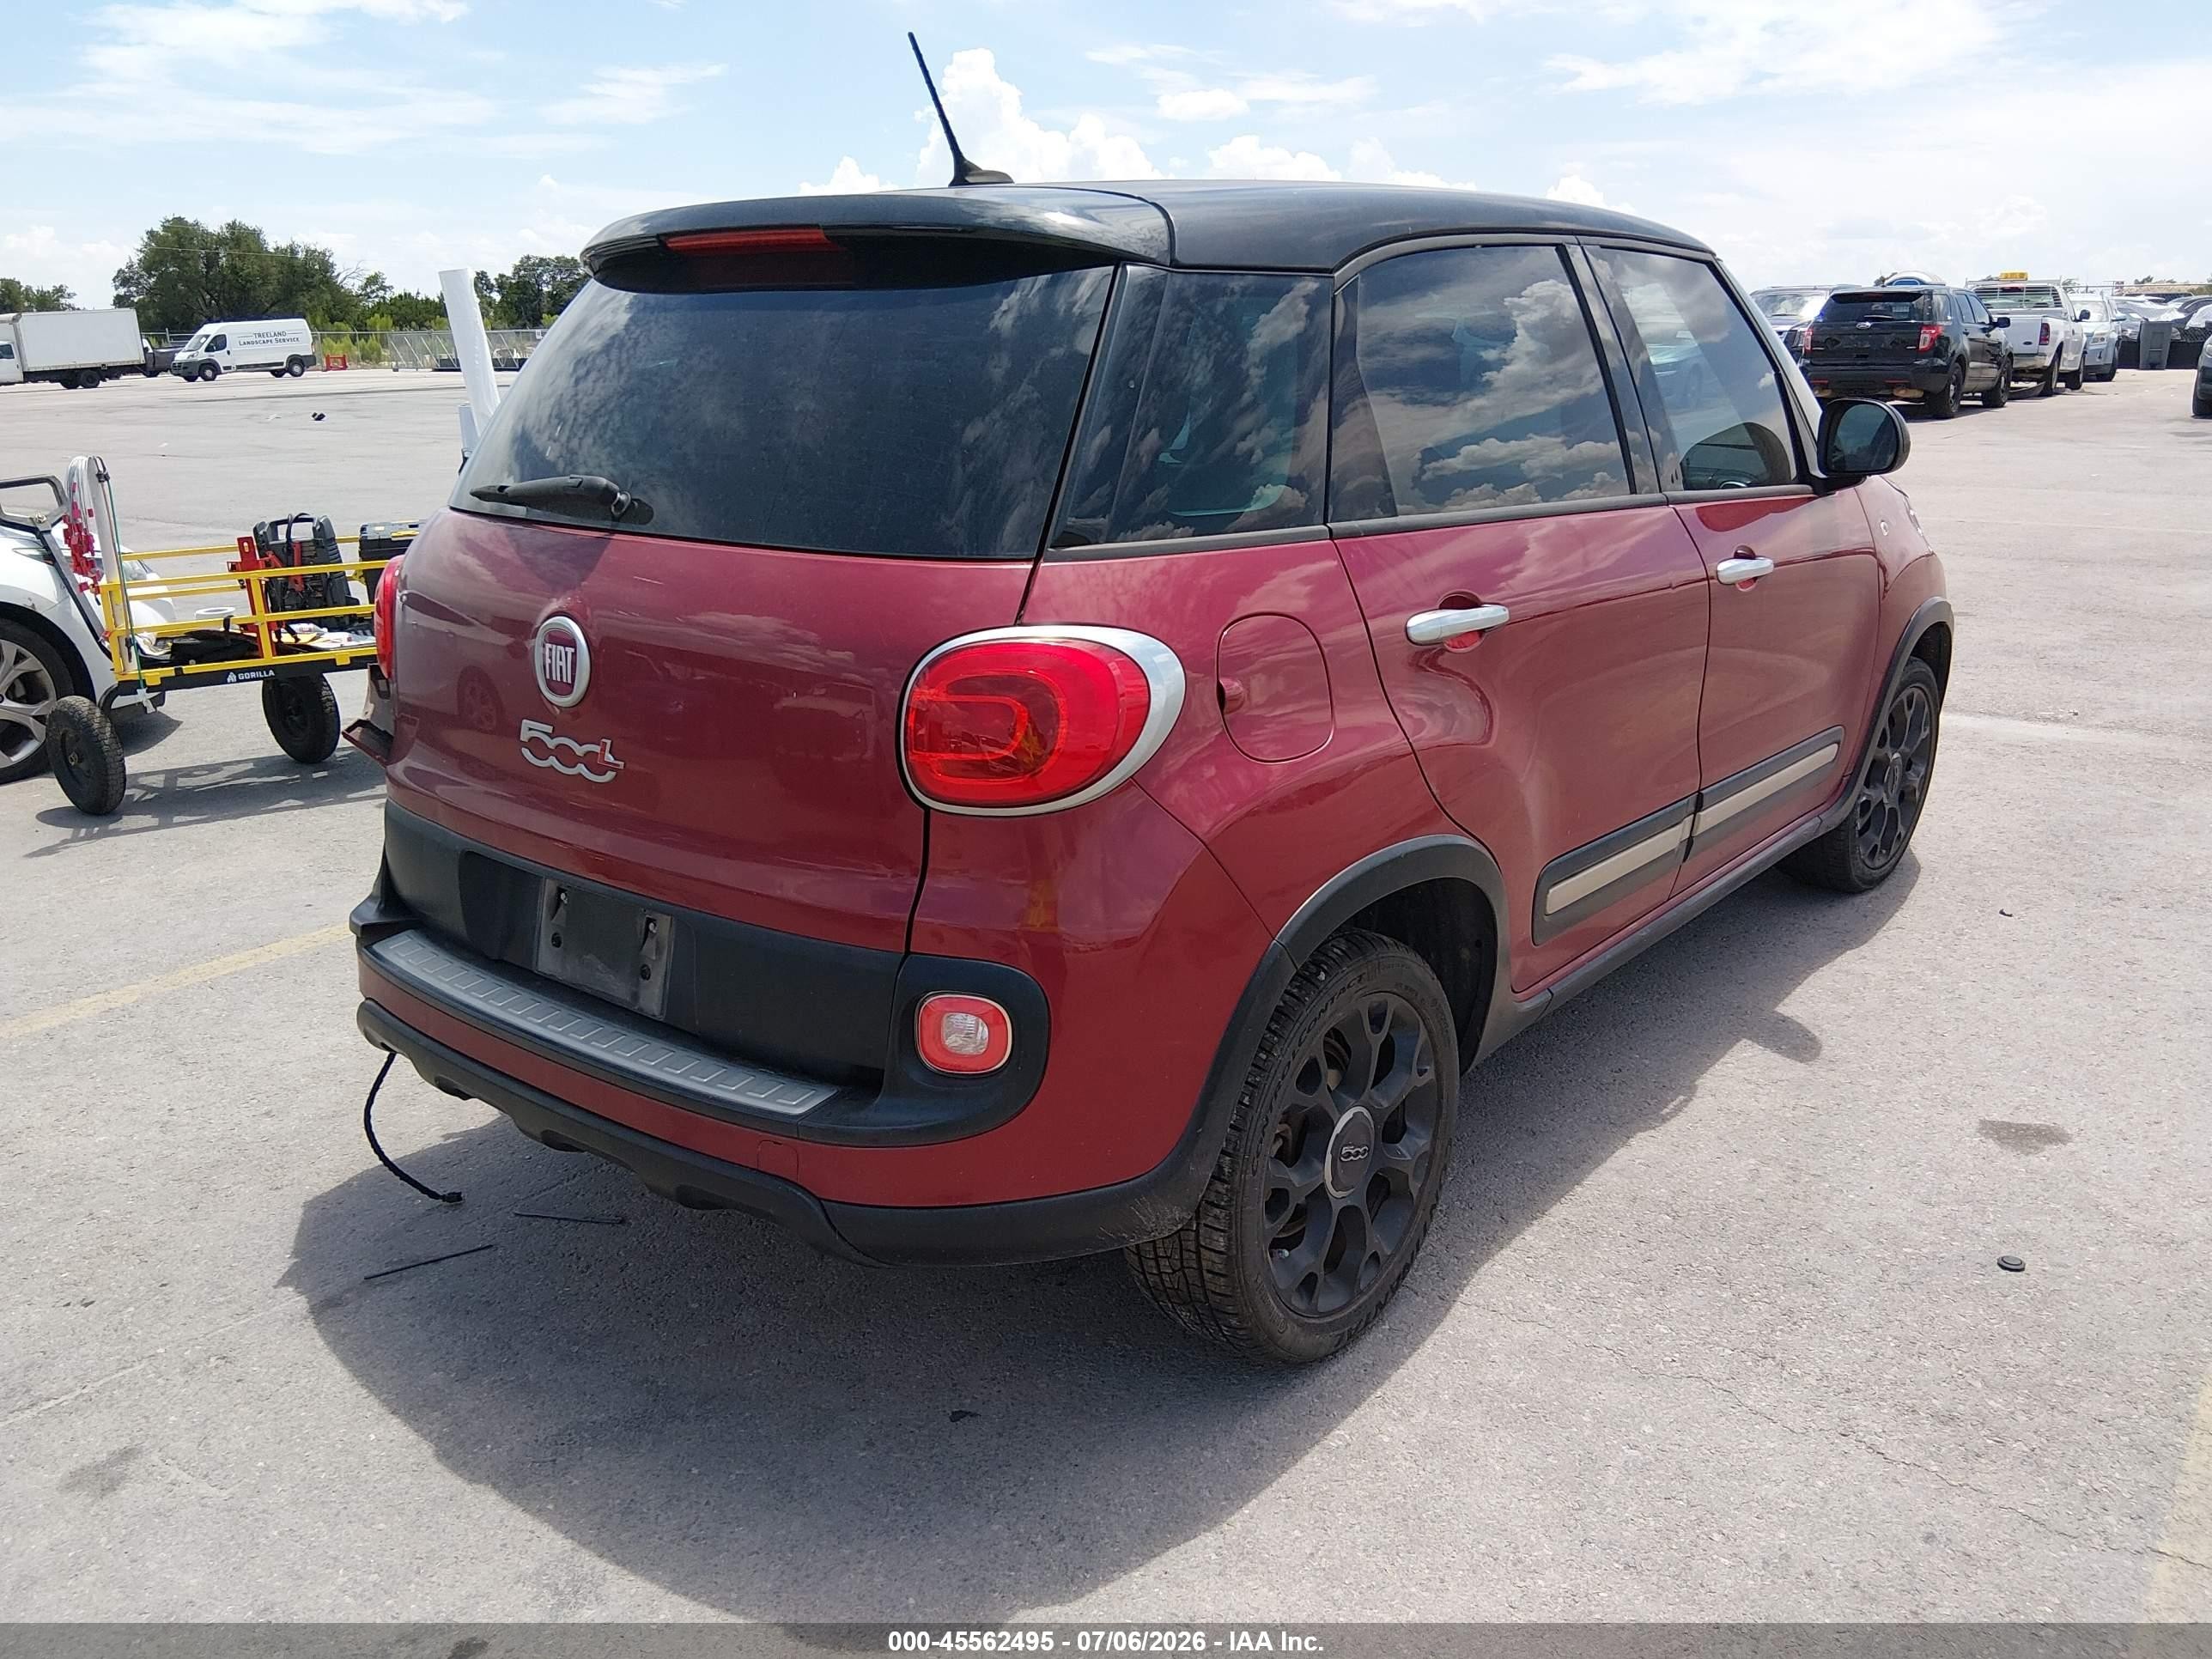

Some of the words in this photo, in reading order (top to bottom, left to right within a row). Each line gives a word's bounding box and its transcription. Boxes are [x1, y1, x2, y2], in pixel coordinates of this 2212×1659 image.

[544, 642, 576, 684] FIAT
[239, 670, 275, 680] GORILLA
[1339, 1143, 1370, 1163] 500
